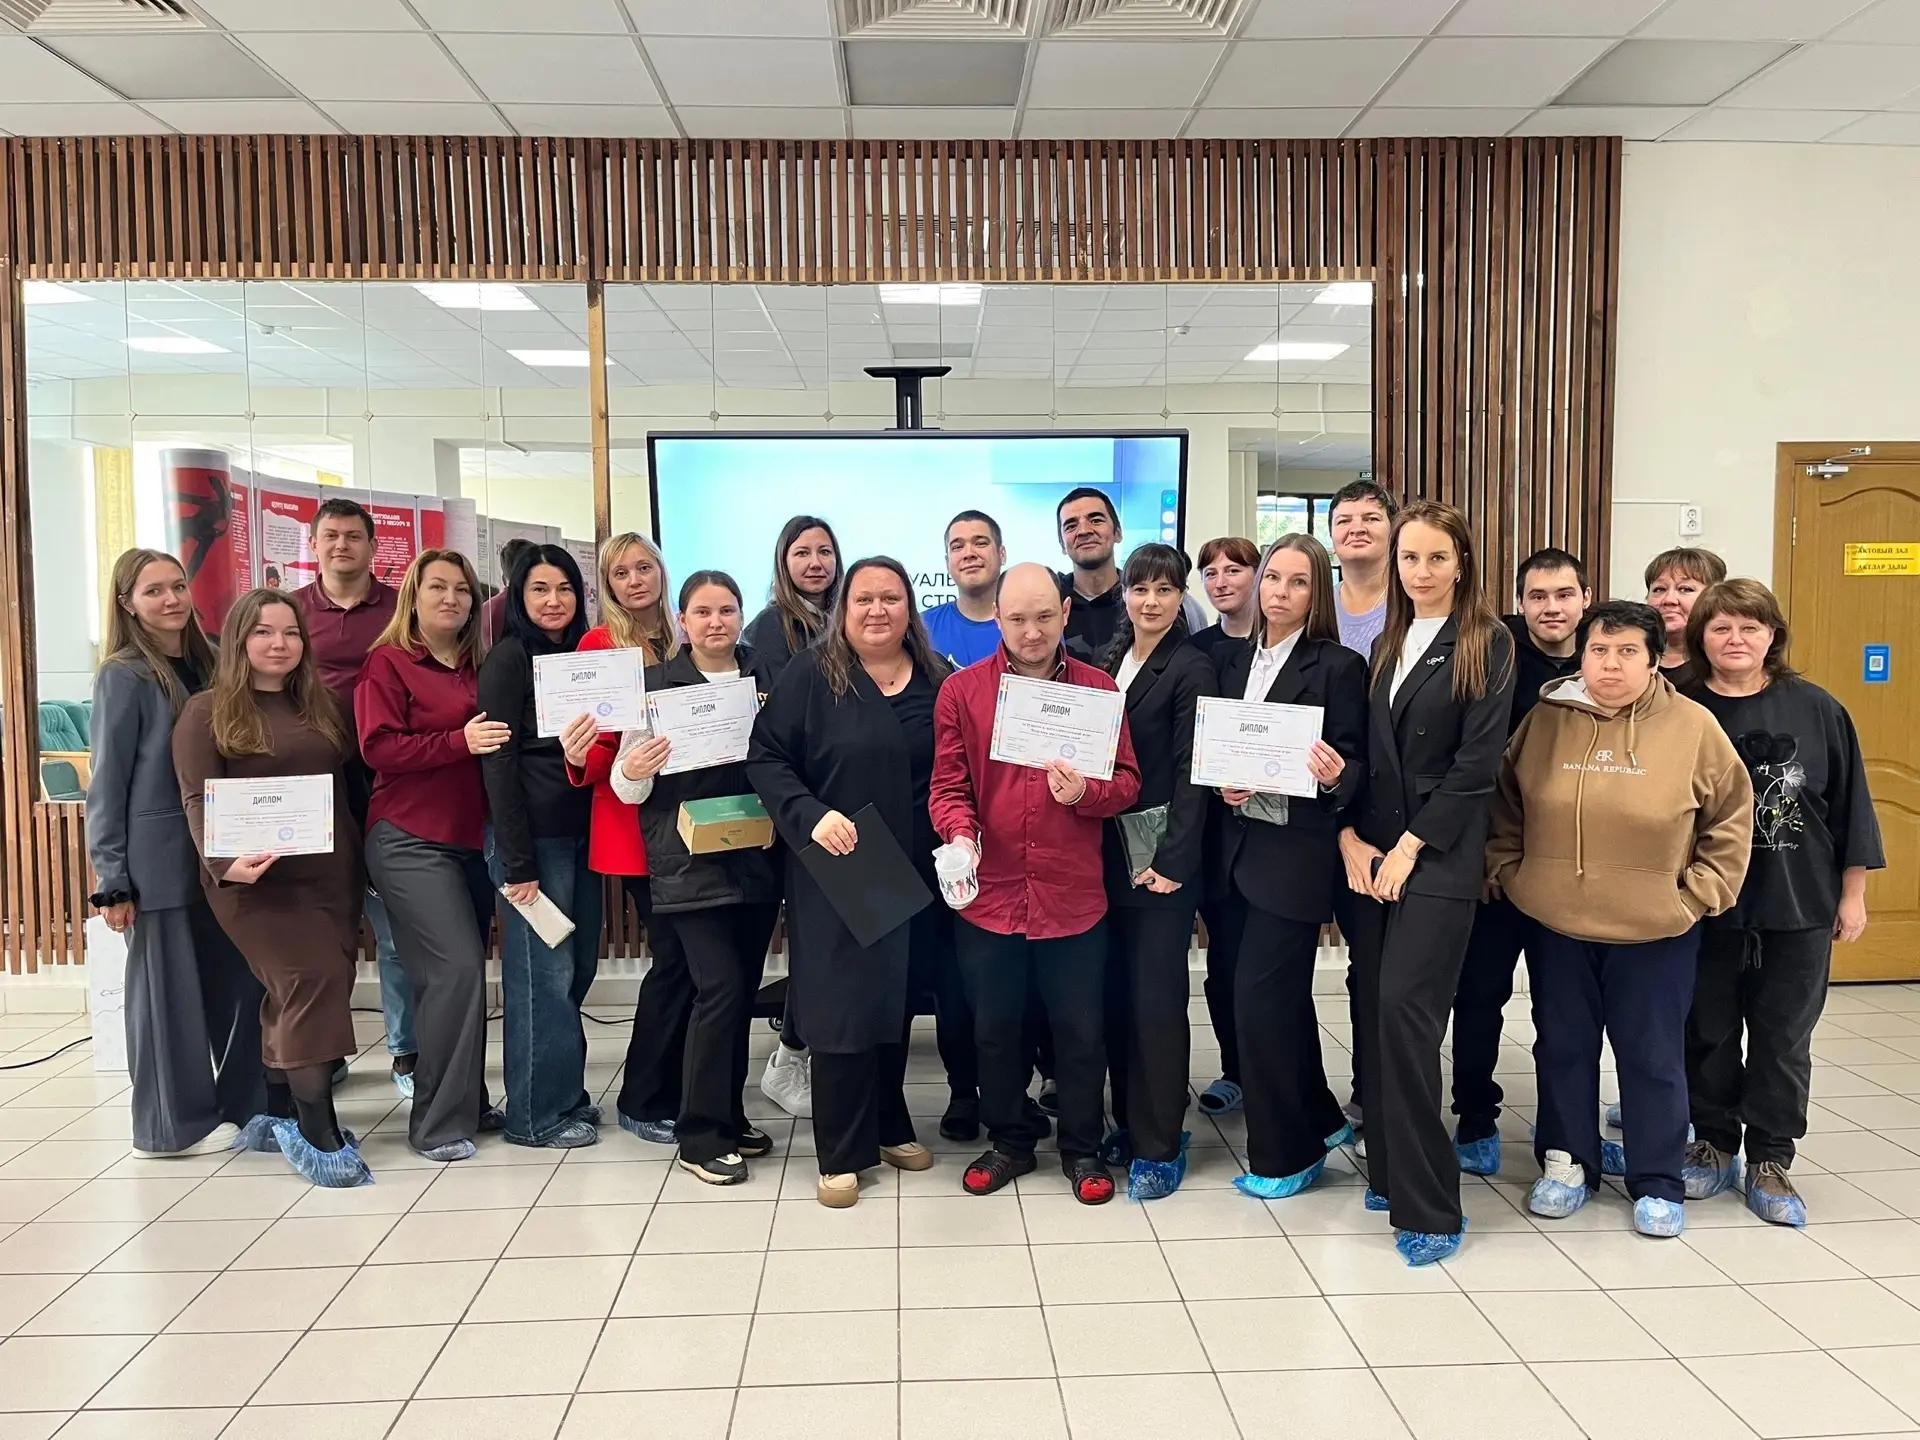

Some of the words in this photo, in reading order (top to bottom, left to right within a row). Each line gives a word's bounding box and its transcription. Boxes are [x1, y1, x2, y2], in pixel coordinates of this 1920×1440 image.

[909, 573, 956, 586] УАЛЬ
[922, 594, 957, 608] СТР
[571, 671, 597, 682] ДИПЛОМ
[691, 703, 716, 716] ДИПЛОМ
[1041, 703, 1071, 716] ДИПЛОМ
[1239, 722, 1269, 734] ДИПЛОМ
[1603, 766, 1647, 775] REPUBLIC
[252, 796, 282, 805] ДИПЛОМ
